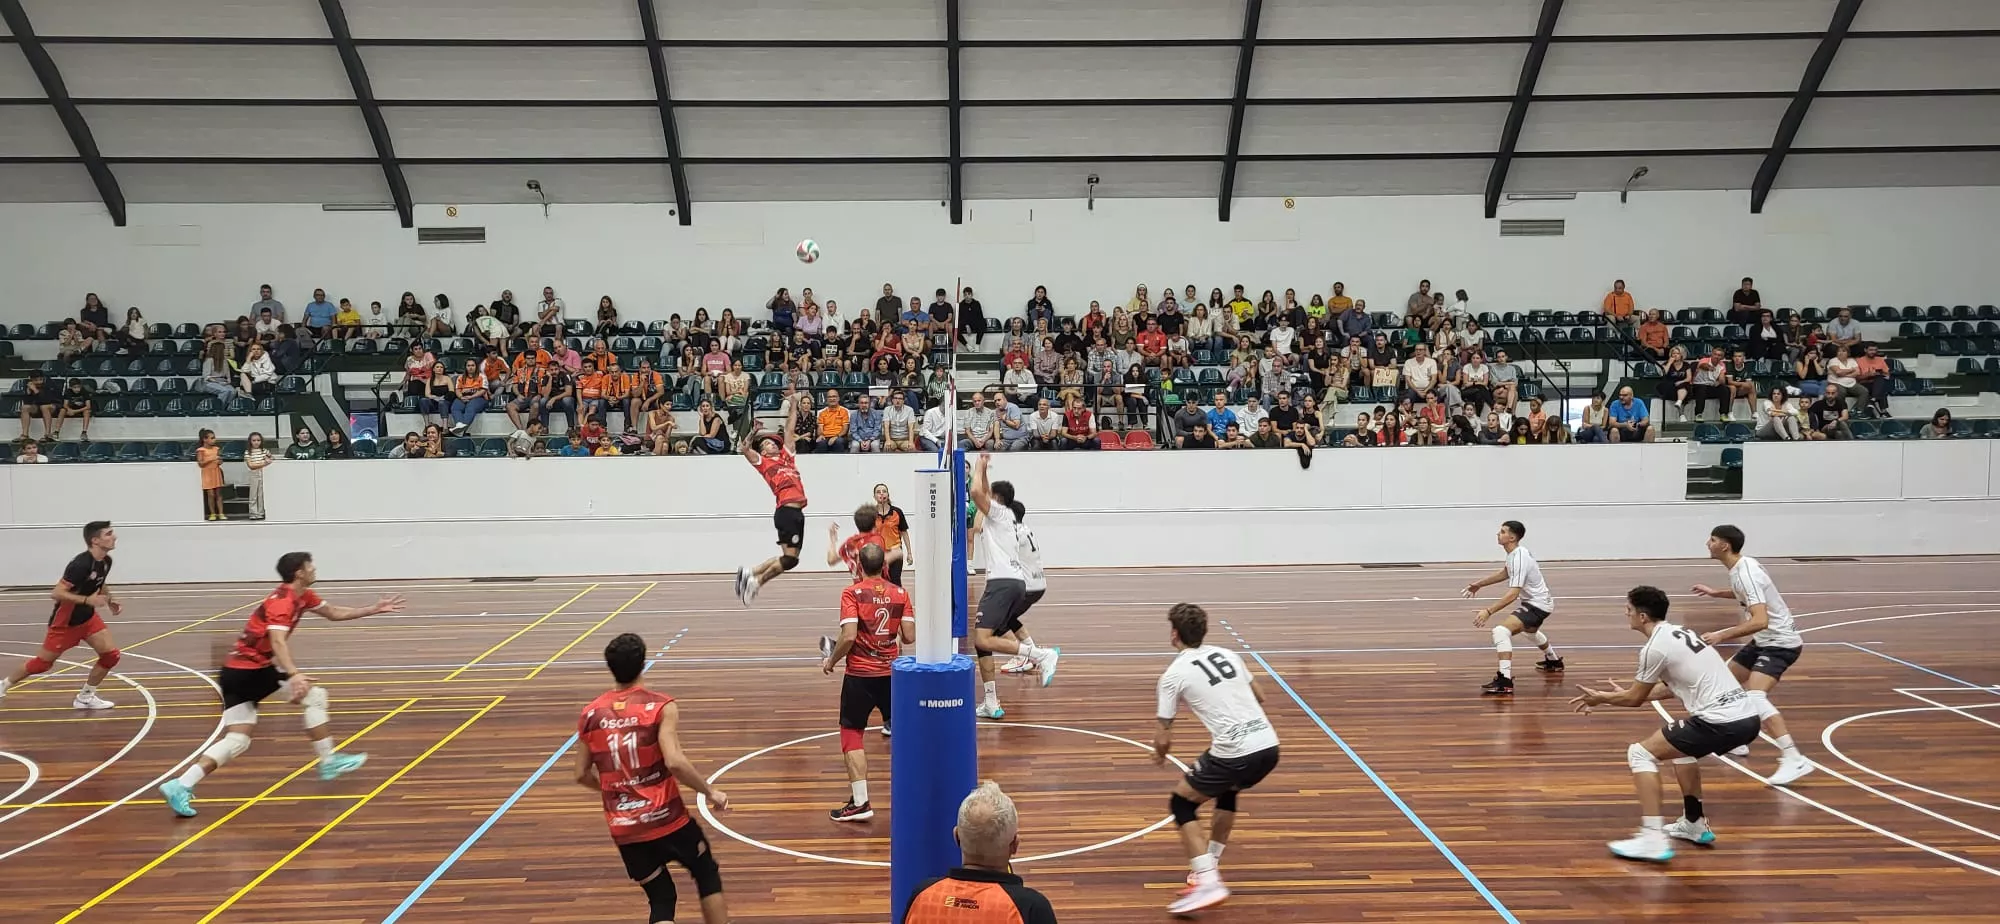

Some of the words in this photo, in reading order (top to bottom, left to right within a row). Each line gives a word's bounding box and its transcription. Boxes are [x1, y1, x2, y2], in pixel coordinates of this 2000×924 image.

[874, 607, 890, 636] 2
[1191, 652, 1238, 687] 16
[927, 699, 963, 708] MONDO
[600, 716, 639, 729] ÓSCAR
[606, 731, 640, 771] 11
